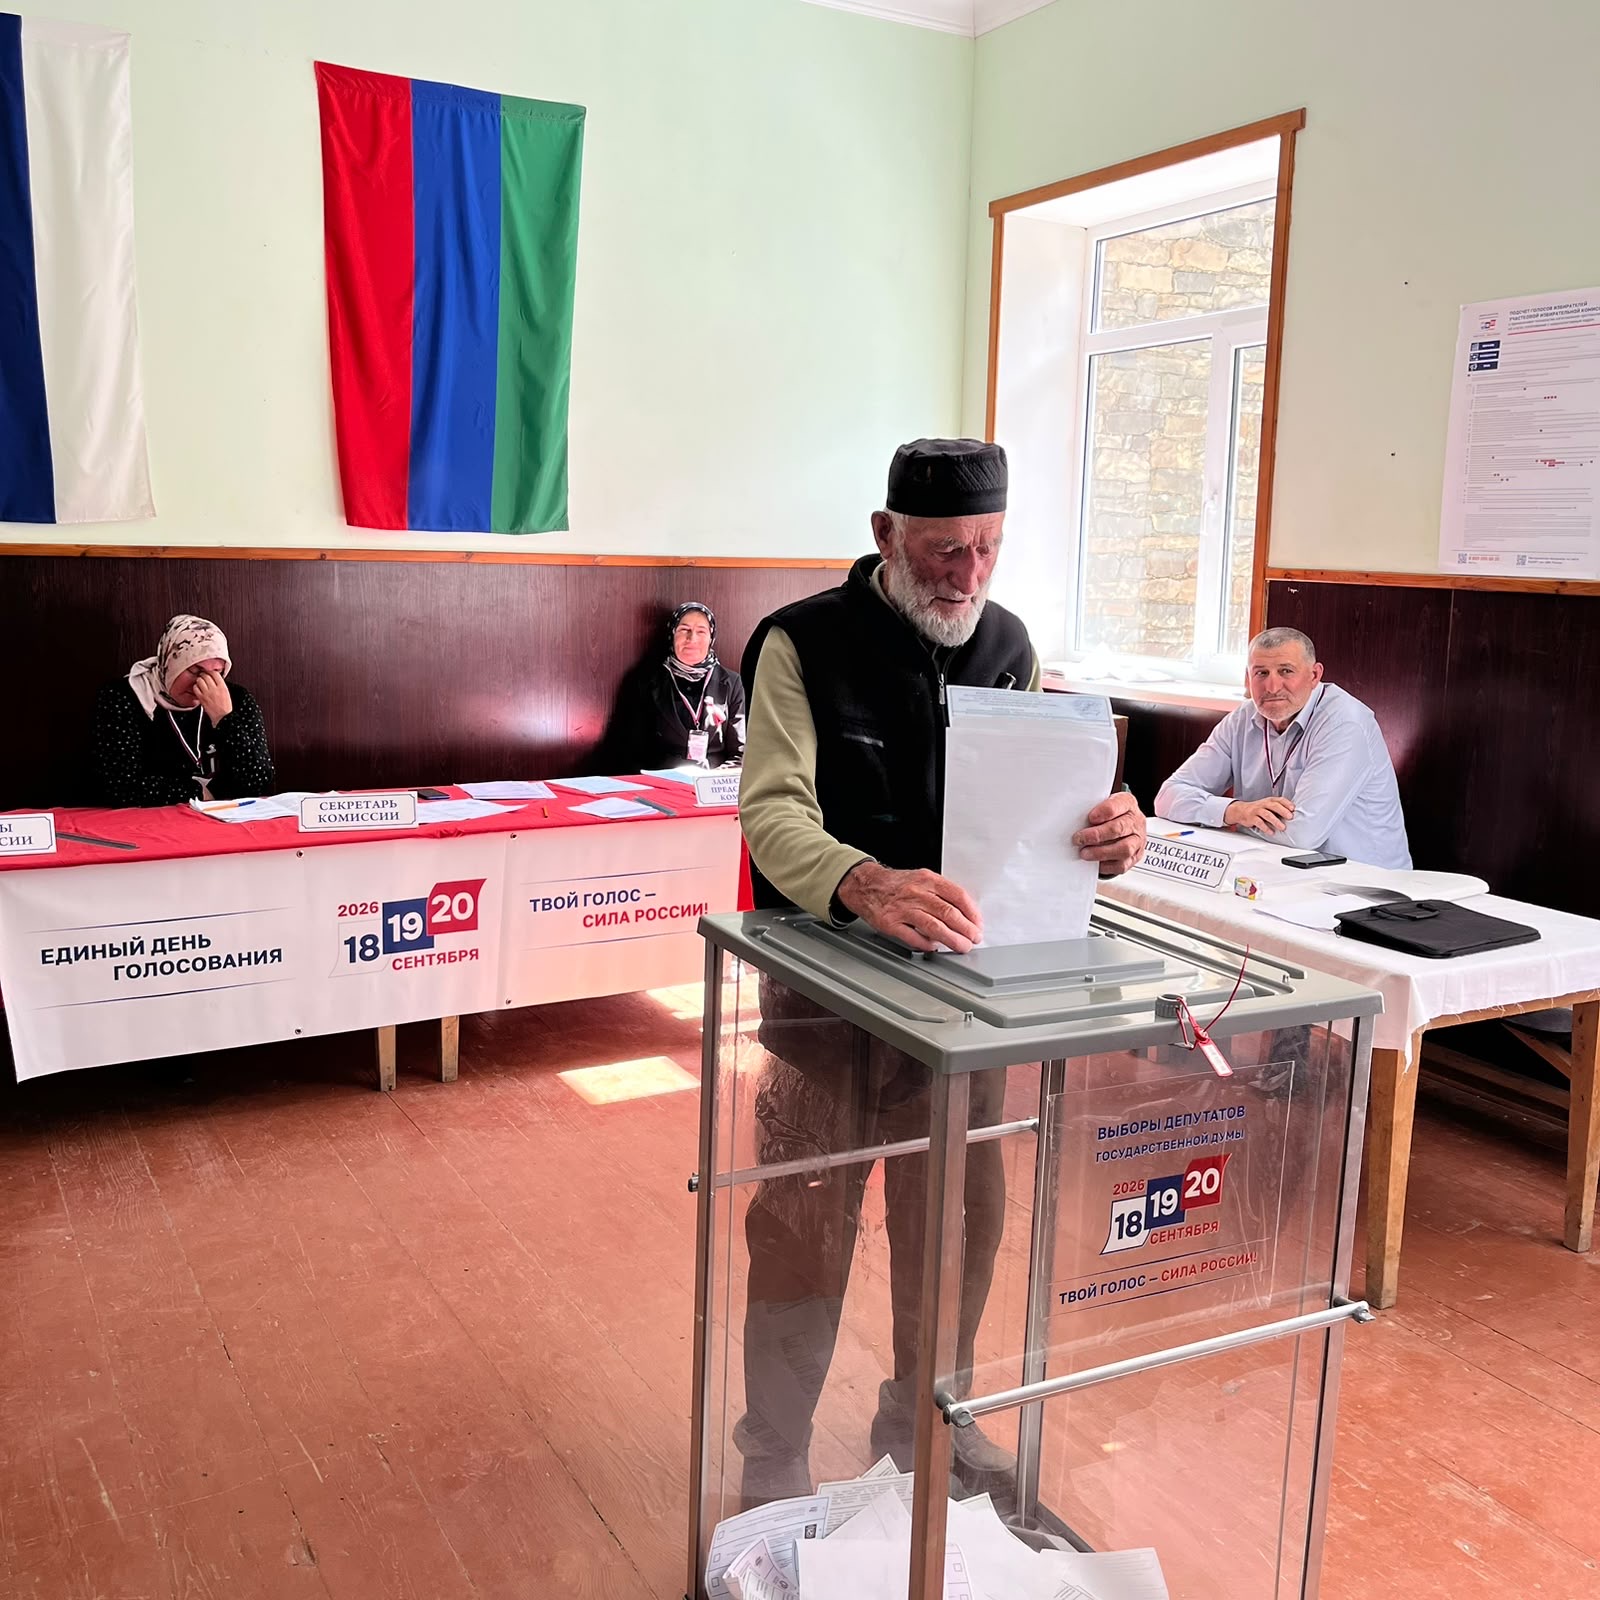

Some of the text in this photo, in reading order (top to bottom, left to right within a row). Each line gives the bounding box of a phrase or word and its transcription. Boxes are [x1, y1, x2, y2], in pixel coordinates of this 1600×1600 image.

[1509, 313, 1539, 321] УЧАСТКОВОЙ
[1540, 309, 1581, 317] ИЗБИРАТЕЛЬНОЙ
[1553, 301, 1588, 310] ИЗБИРАТЕЛЕЙ
[318, 812, 400, 823] КОМИССИИ
[319, 800, 398, 811] СЕКРЕТАРЬ
[1144, 855, 1210, 879] КОМИССИИ
[338, 901, 379, 917] 2026
[529, 892, 578, 913] ТВОЙ
[583, 889, 641, 907] ГОЛОС
[582, 902, 709, 928] СИЛА РОССИИ!
[343, 892, 474, 963] 18 19 20
[41, 934, 211, 965] ЕДИНЫЙ ДЕНЬ
[392, 948, 479, 970] СЕНТЯБРЯ
[114, 948, 283, 980] ГОЛОСОВАНИЯ
[1097, 1105, 1246, 1141] ВЫБОРЫ ДЕПУТАТОВ
[1096, 1129, 1244, 1163] ГОСУДАРСТВЕННОЙ ДУМЫ
[1112, 1179, 1145, 1195] 2026
[1114, 1168, 1220, 1240] 18 19 20
[1149, 1220, 1219, 1245] СЕНТЯБРЯ
[1059, 1282, 1097, 1305] ТВОЙ
[1100, 1274, 1146, 1296] ГОЛОС
[1161, 1265, 1197, 1282] СИЛА
[1200, 1251, 1257, 1273] РОССИИ!
